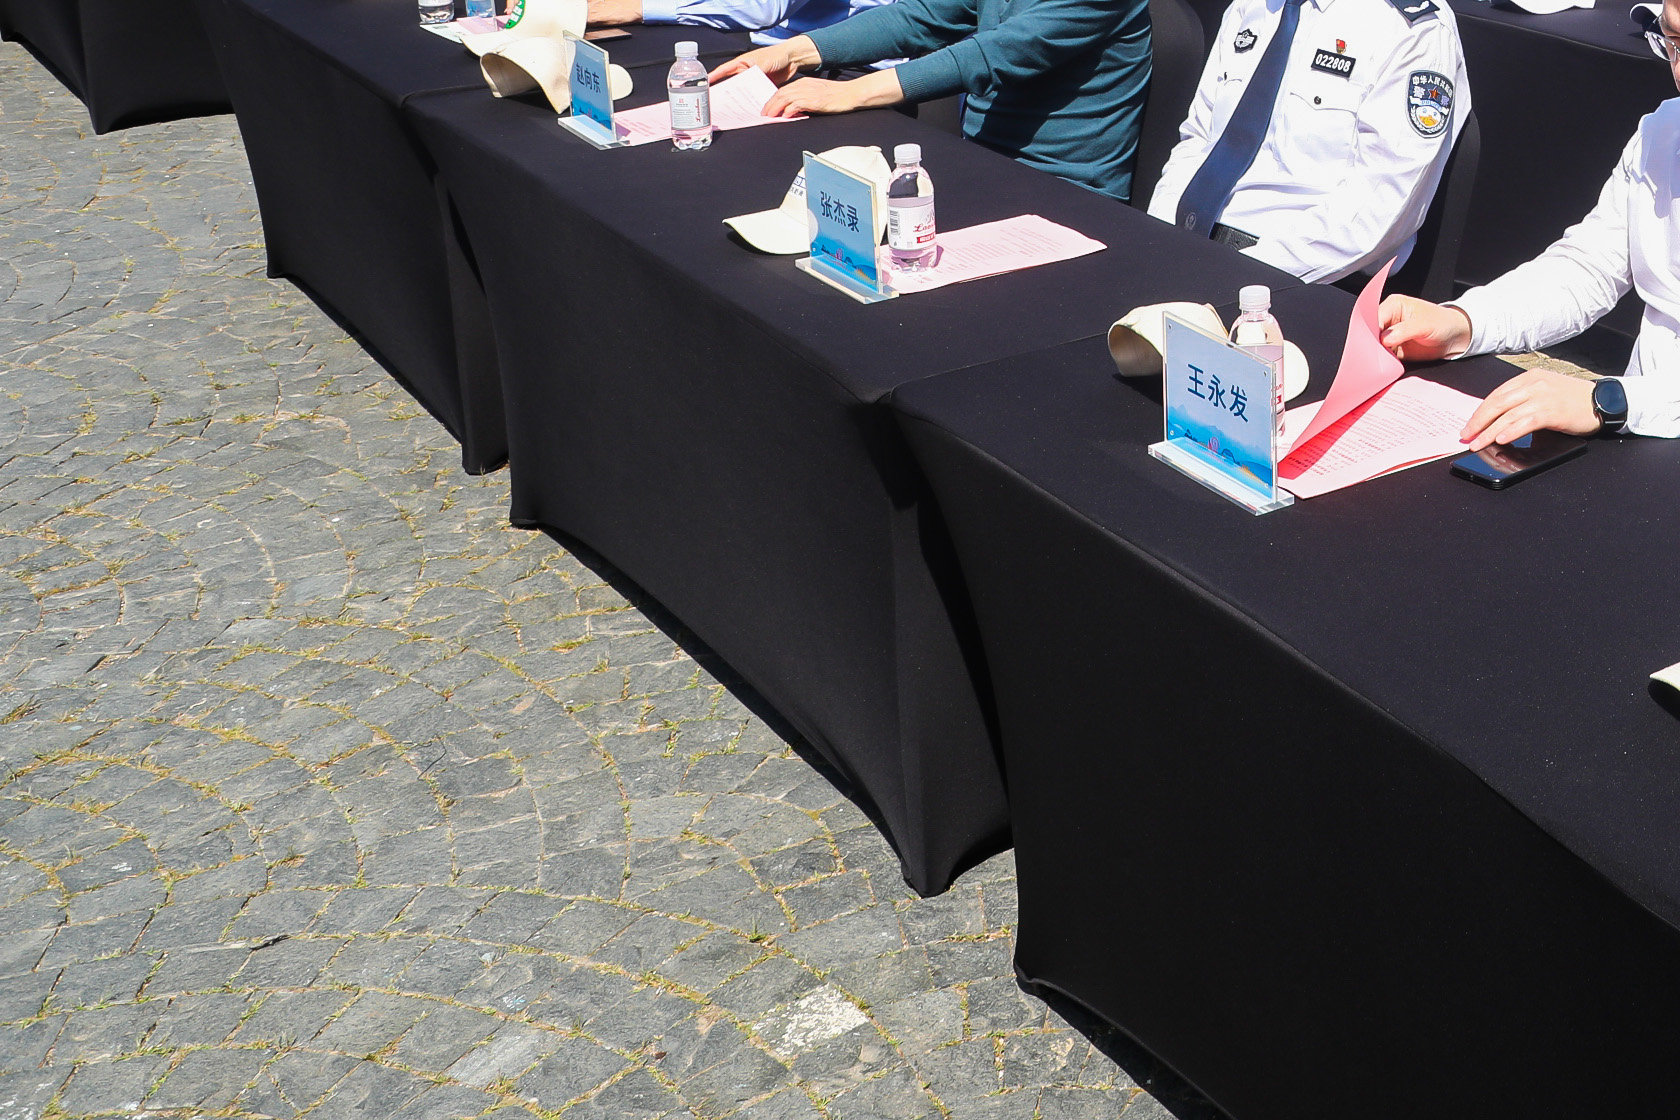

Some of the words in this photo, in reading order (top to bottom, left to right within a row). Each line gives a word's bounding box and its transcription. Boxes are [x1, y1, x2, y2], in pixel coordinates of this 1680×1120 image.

[576, 64, 601, 93] 赵向东
[1315, 53, 1352, 72] 022808
[820, 191, 860, 232] 张杰录
[1187, 363, 1249, 423] 王永发
